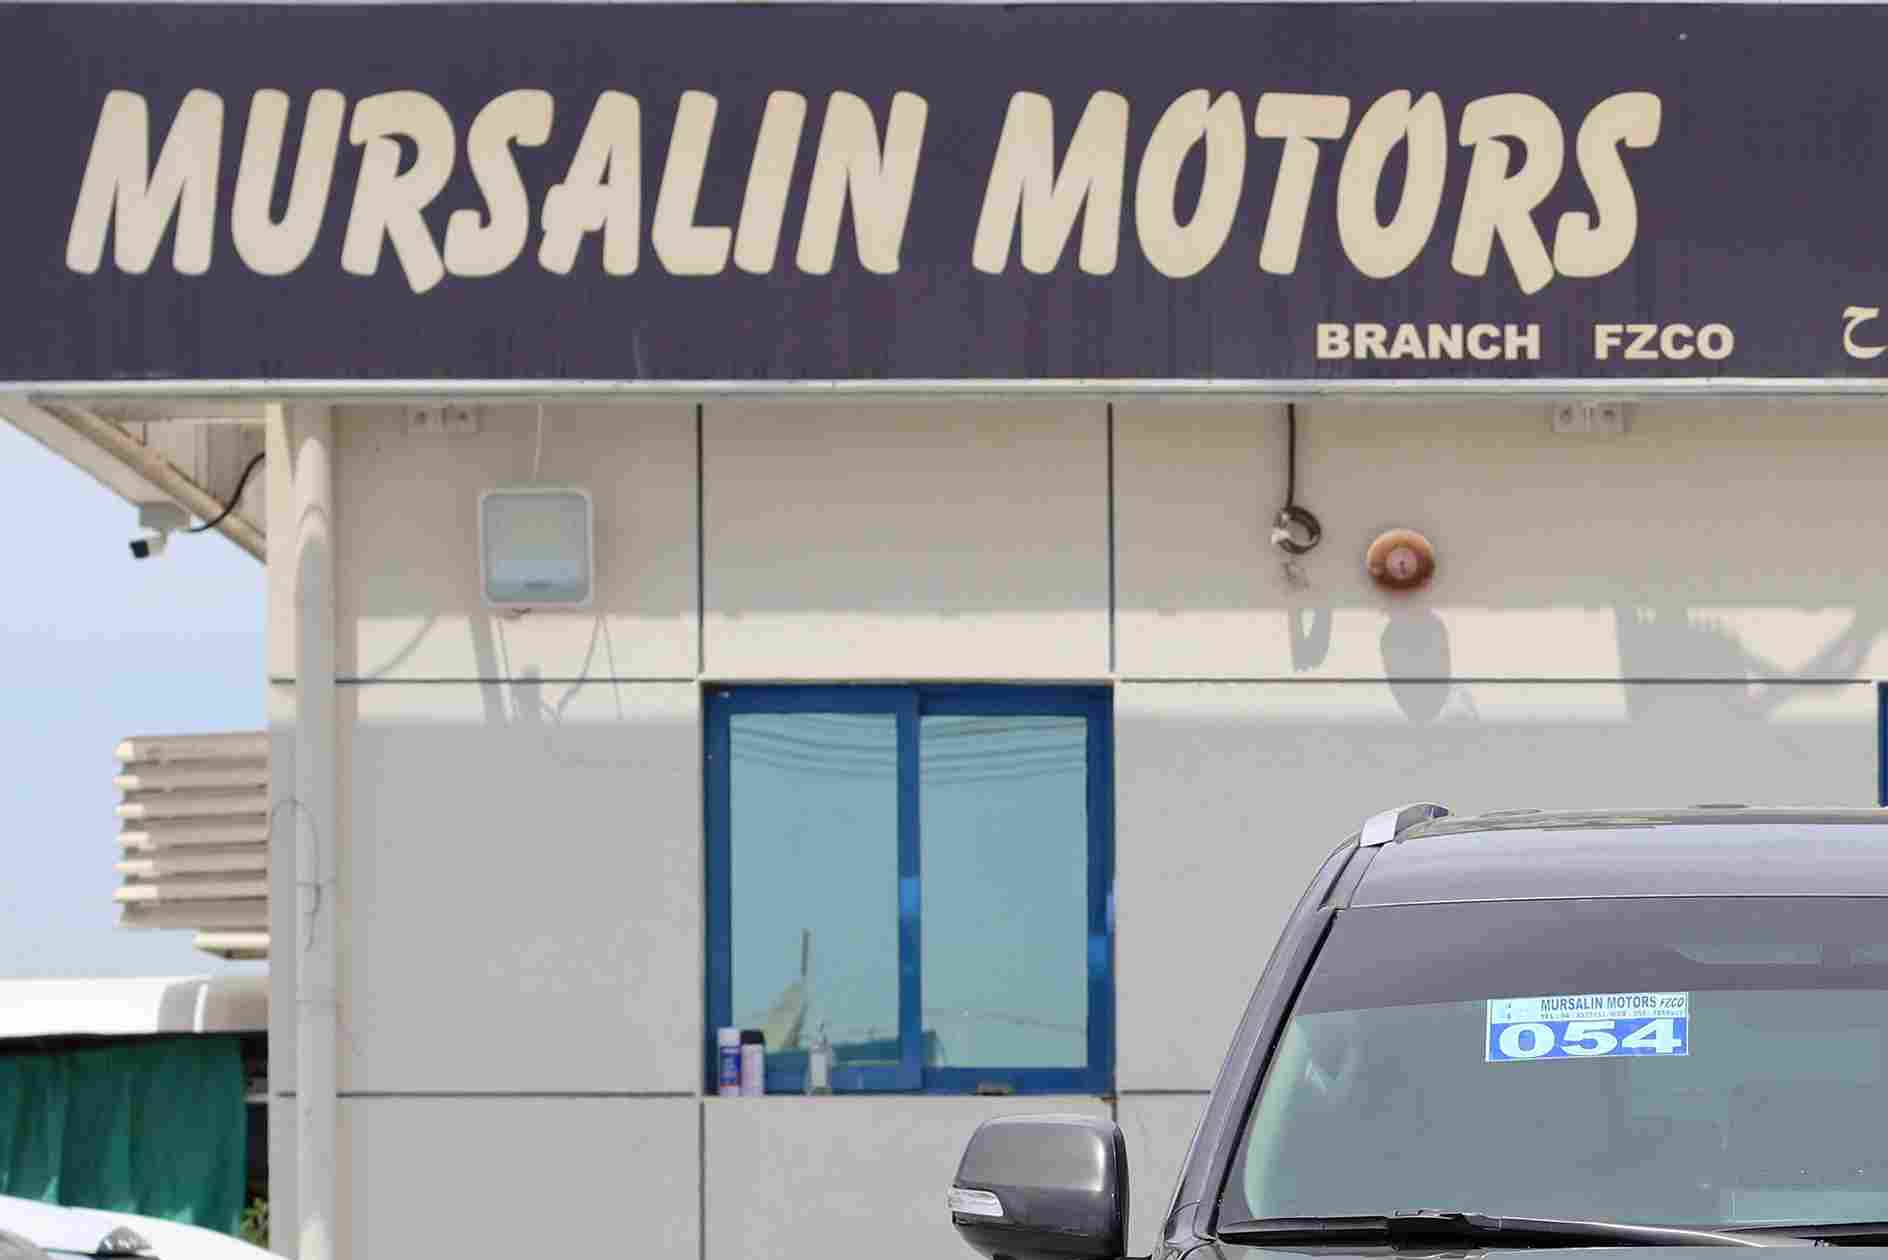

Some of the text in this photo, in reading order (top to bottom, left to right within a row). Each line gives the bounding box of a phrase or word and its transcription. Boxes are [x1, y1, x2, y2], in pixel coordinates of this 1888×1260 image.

[67, 89, 1662, 295] MURSALIN MOTORS
[1316, 322, 1734, 360] BRANCH FZCO
[1842, 306, 1888, 359] ح
[1541, 995, 1686, 1012] MURSALIN MOTORS FZCO
[1498, 1018, 1682, 1058] 054
